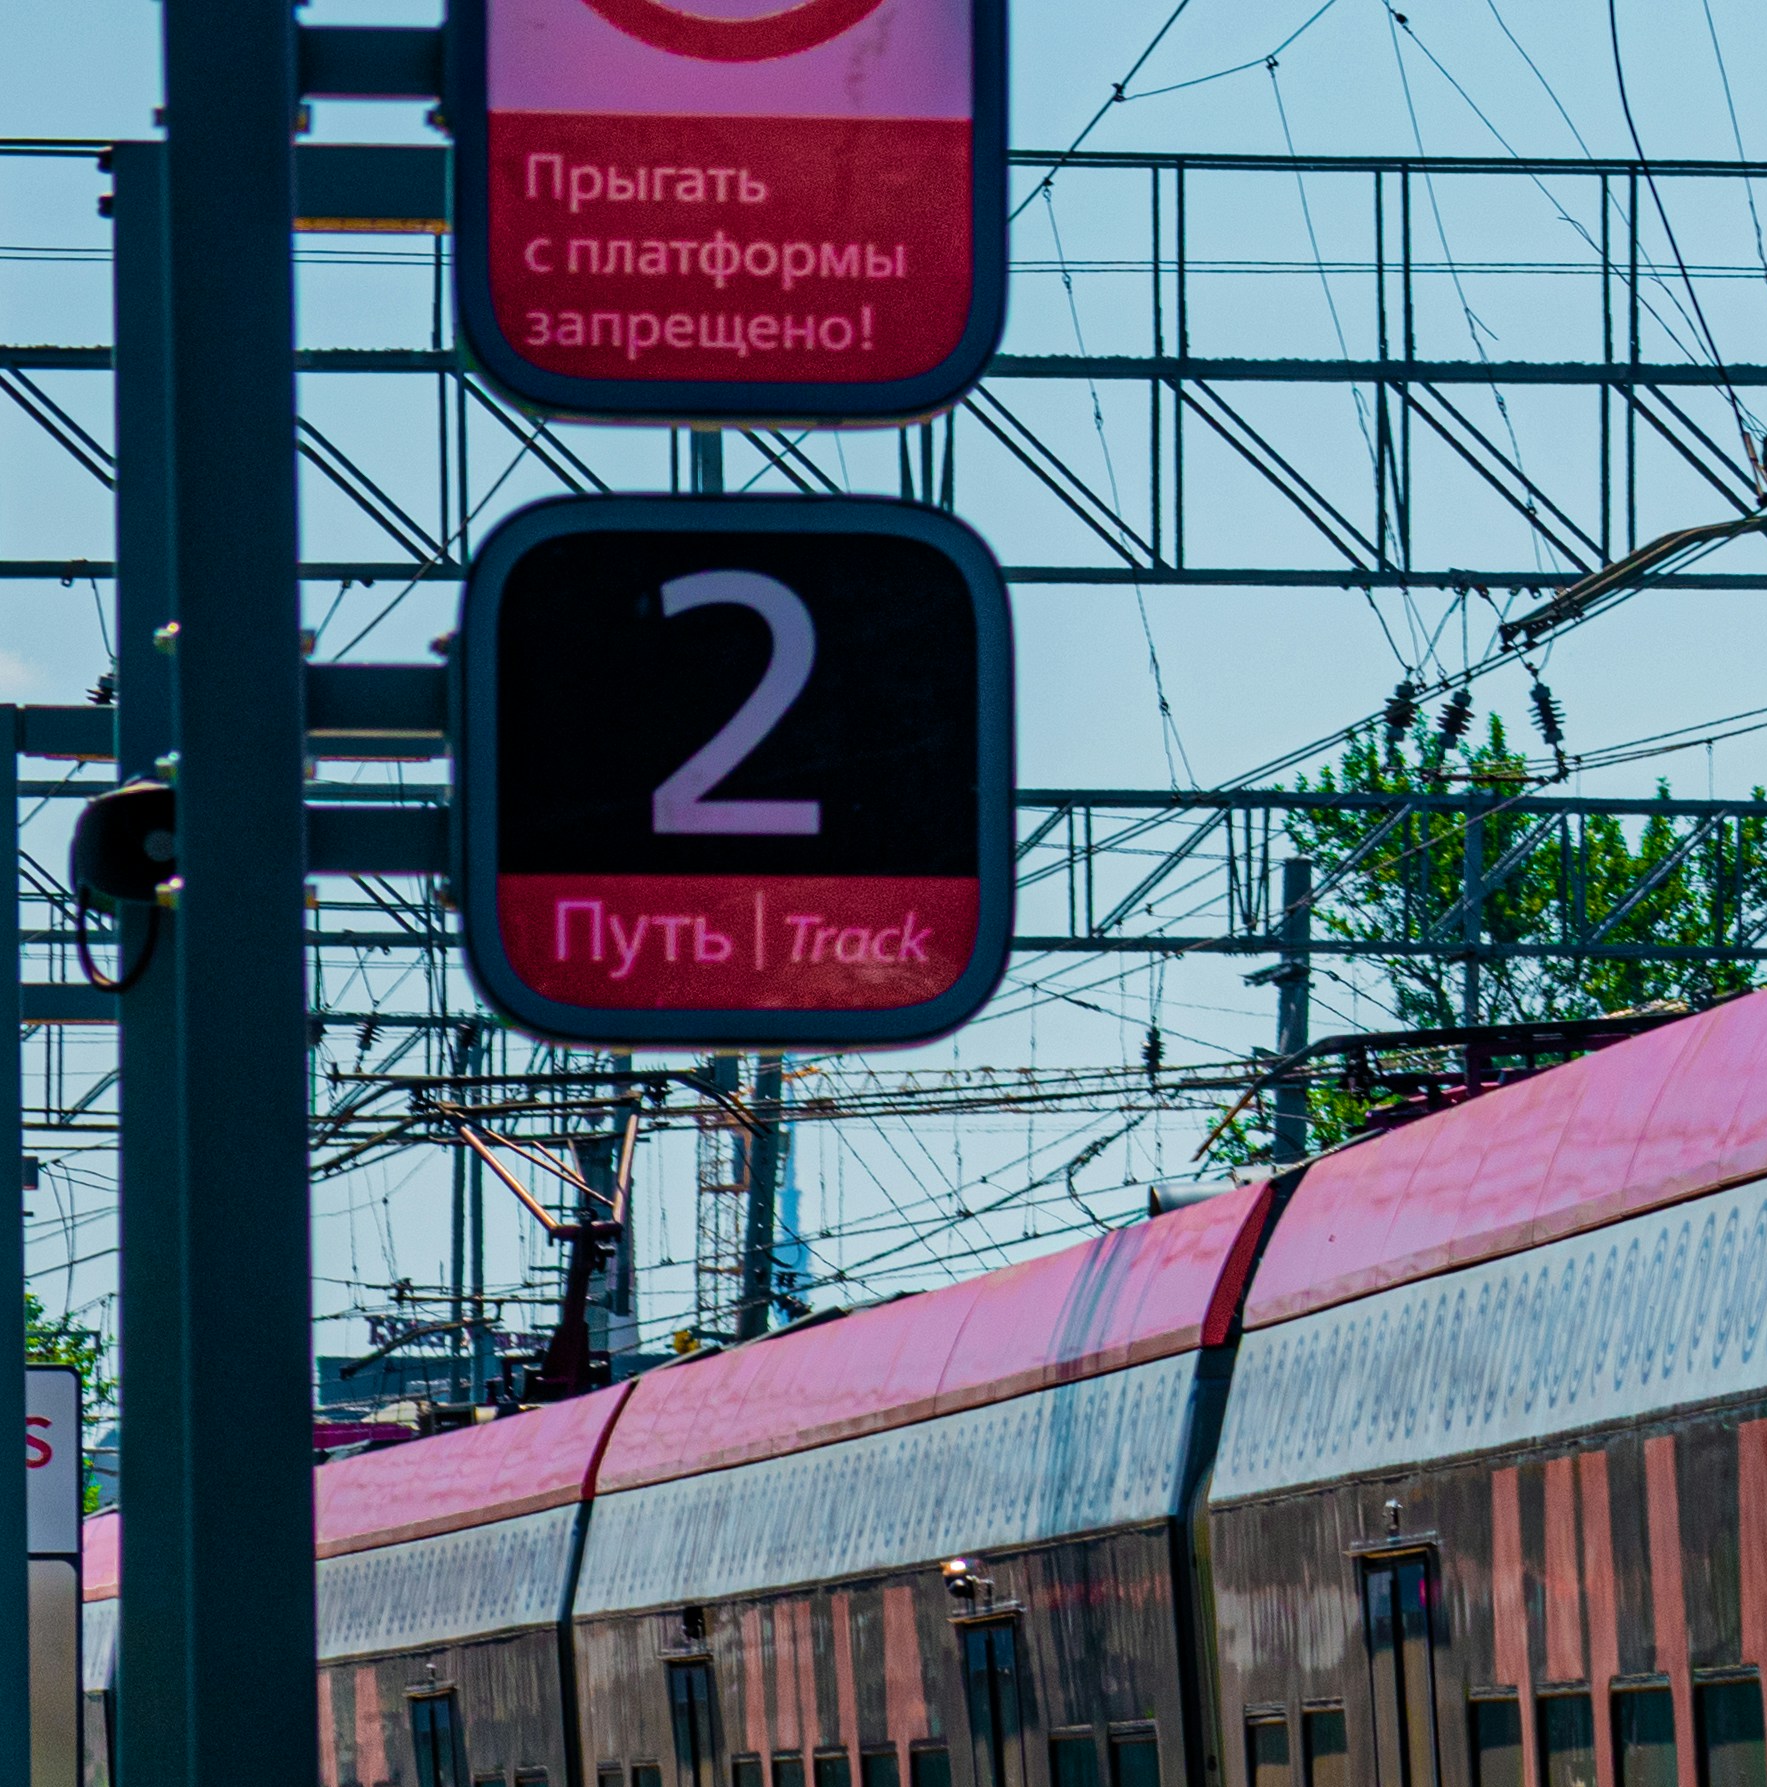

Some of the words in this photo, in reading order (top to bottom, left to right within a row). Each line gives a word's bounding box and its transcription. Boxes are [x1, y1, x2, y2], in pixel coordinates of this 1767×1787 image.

[526, 152, 769, 214] Прыгать
[524, 236, 554, 274] с
[567, 230, 907, 291] платформы
[524, 305, 875, 361] запрещено!
[651, 569, 821, 835] 2
[554, 898, 733, 979] Путь
[785, 910, 934, 964] Track
